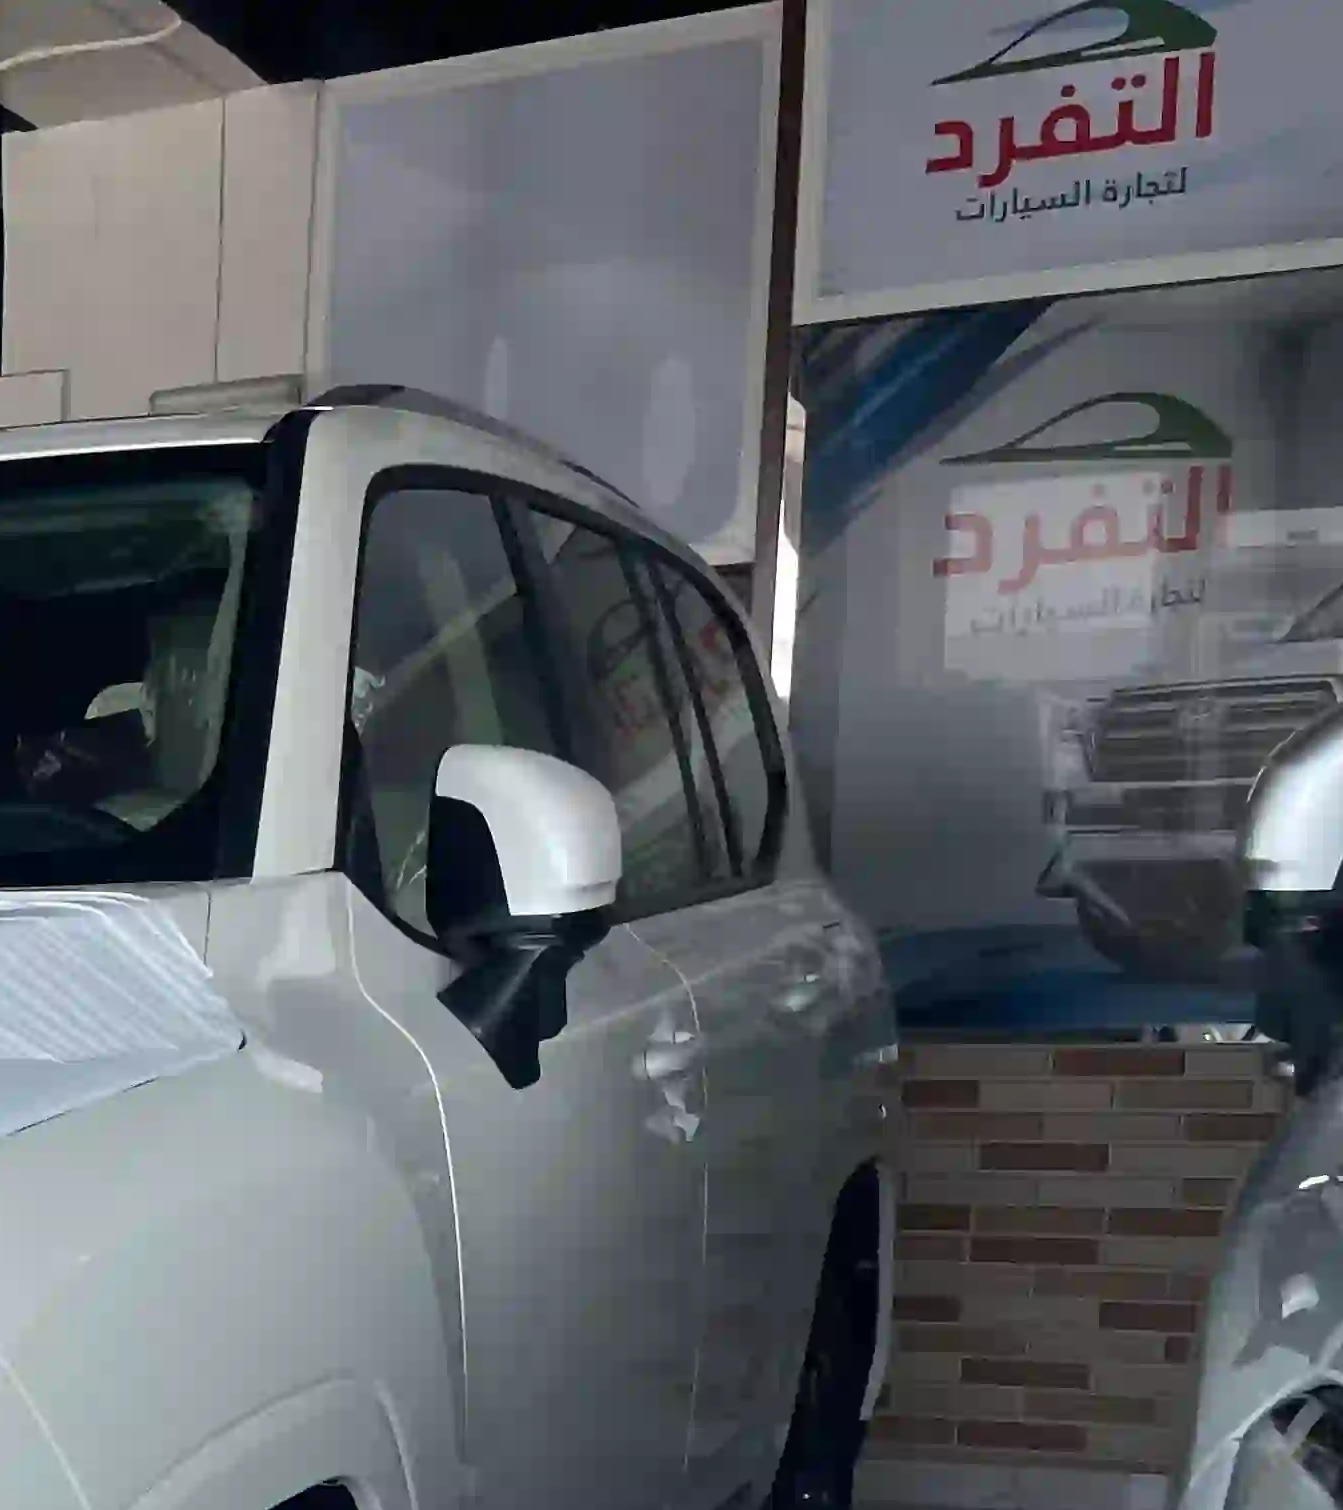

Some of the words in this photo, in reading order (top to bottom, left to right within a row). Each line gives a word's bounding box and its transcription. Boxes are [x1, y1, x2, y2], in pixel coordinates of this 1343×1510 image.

[925, 51, 1215, 188] التفرد
[955, 179, 1091, 223] السيارات
[1102, 166, 1188, 209] لتجارة
[932, 464, 1233, 595] التفرد
